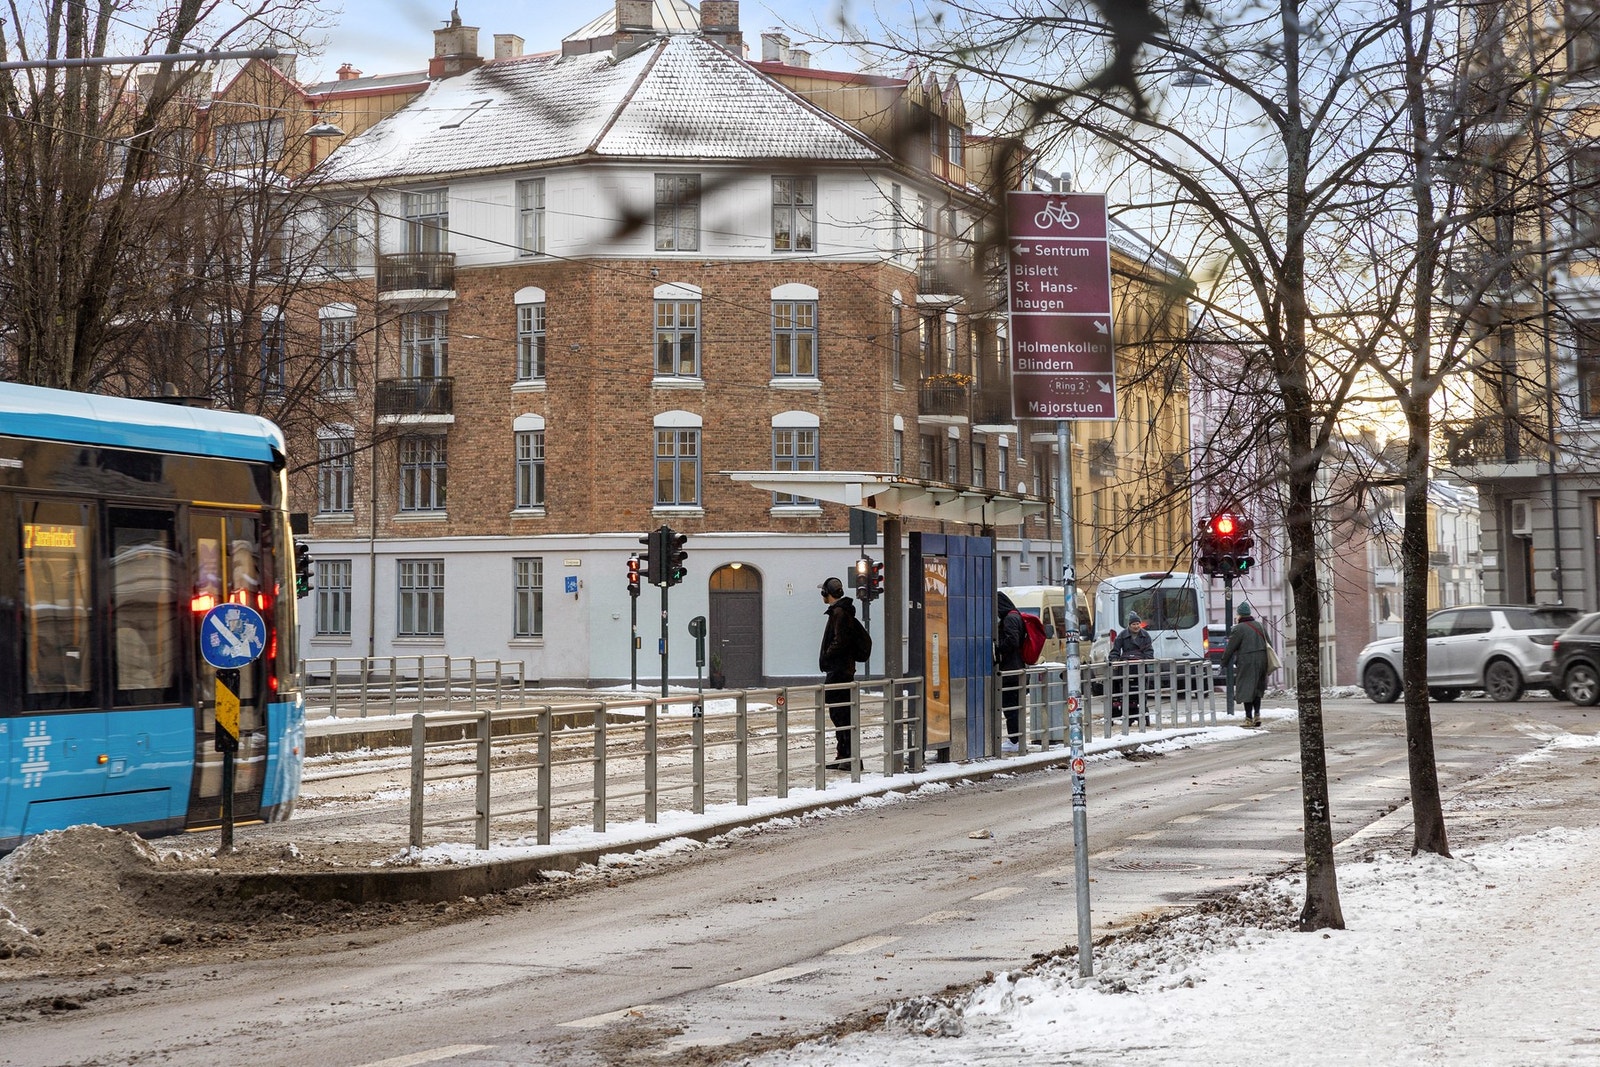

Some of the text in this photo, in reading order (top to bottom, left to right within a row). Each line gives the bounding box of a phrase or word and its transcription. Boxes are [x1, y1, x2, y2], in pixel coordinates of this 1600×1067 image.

[1035, 244, 1089, 257] Sentrum
[1014, 264, 1059, 276] Bislett
[1016, 281, 1078, 293] St. Hans-
[1016, 298, 1064, 311] haugen
[1017, 341, 1108, 353] Holmenkollen
[1018, 358, 1074, 370] Blindern
[1055, 381, 1085, 391] Ring 2
[1028, 400, 1103, 415] Majorstuen
